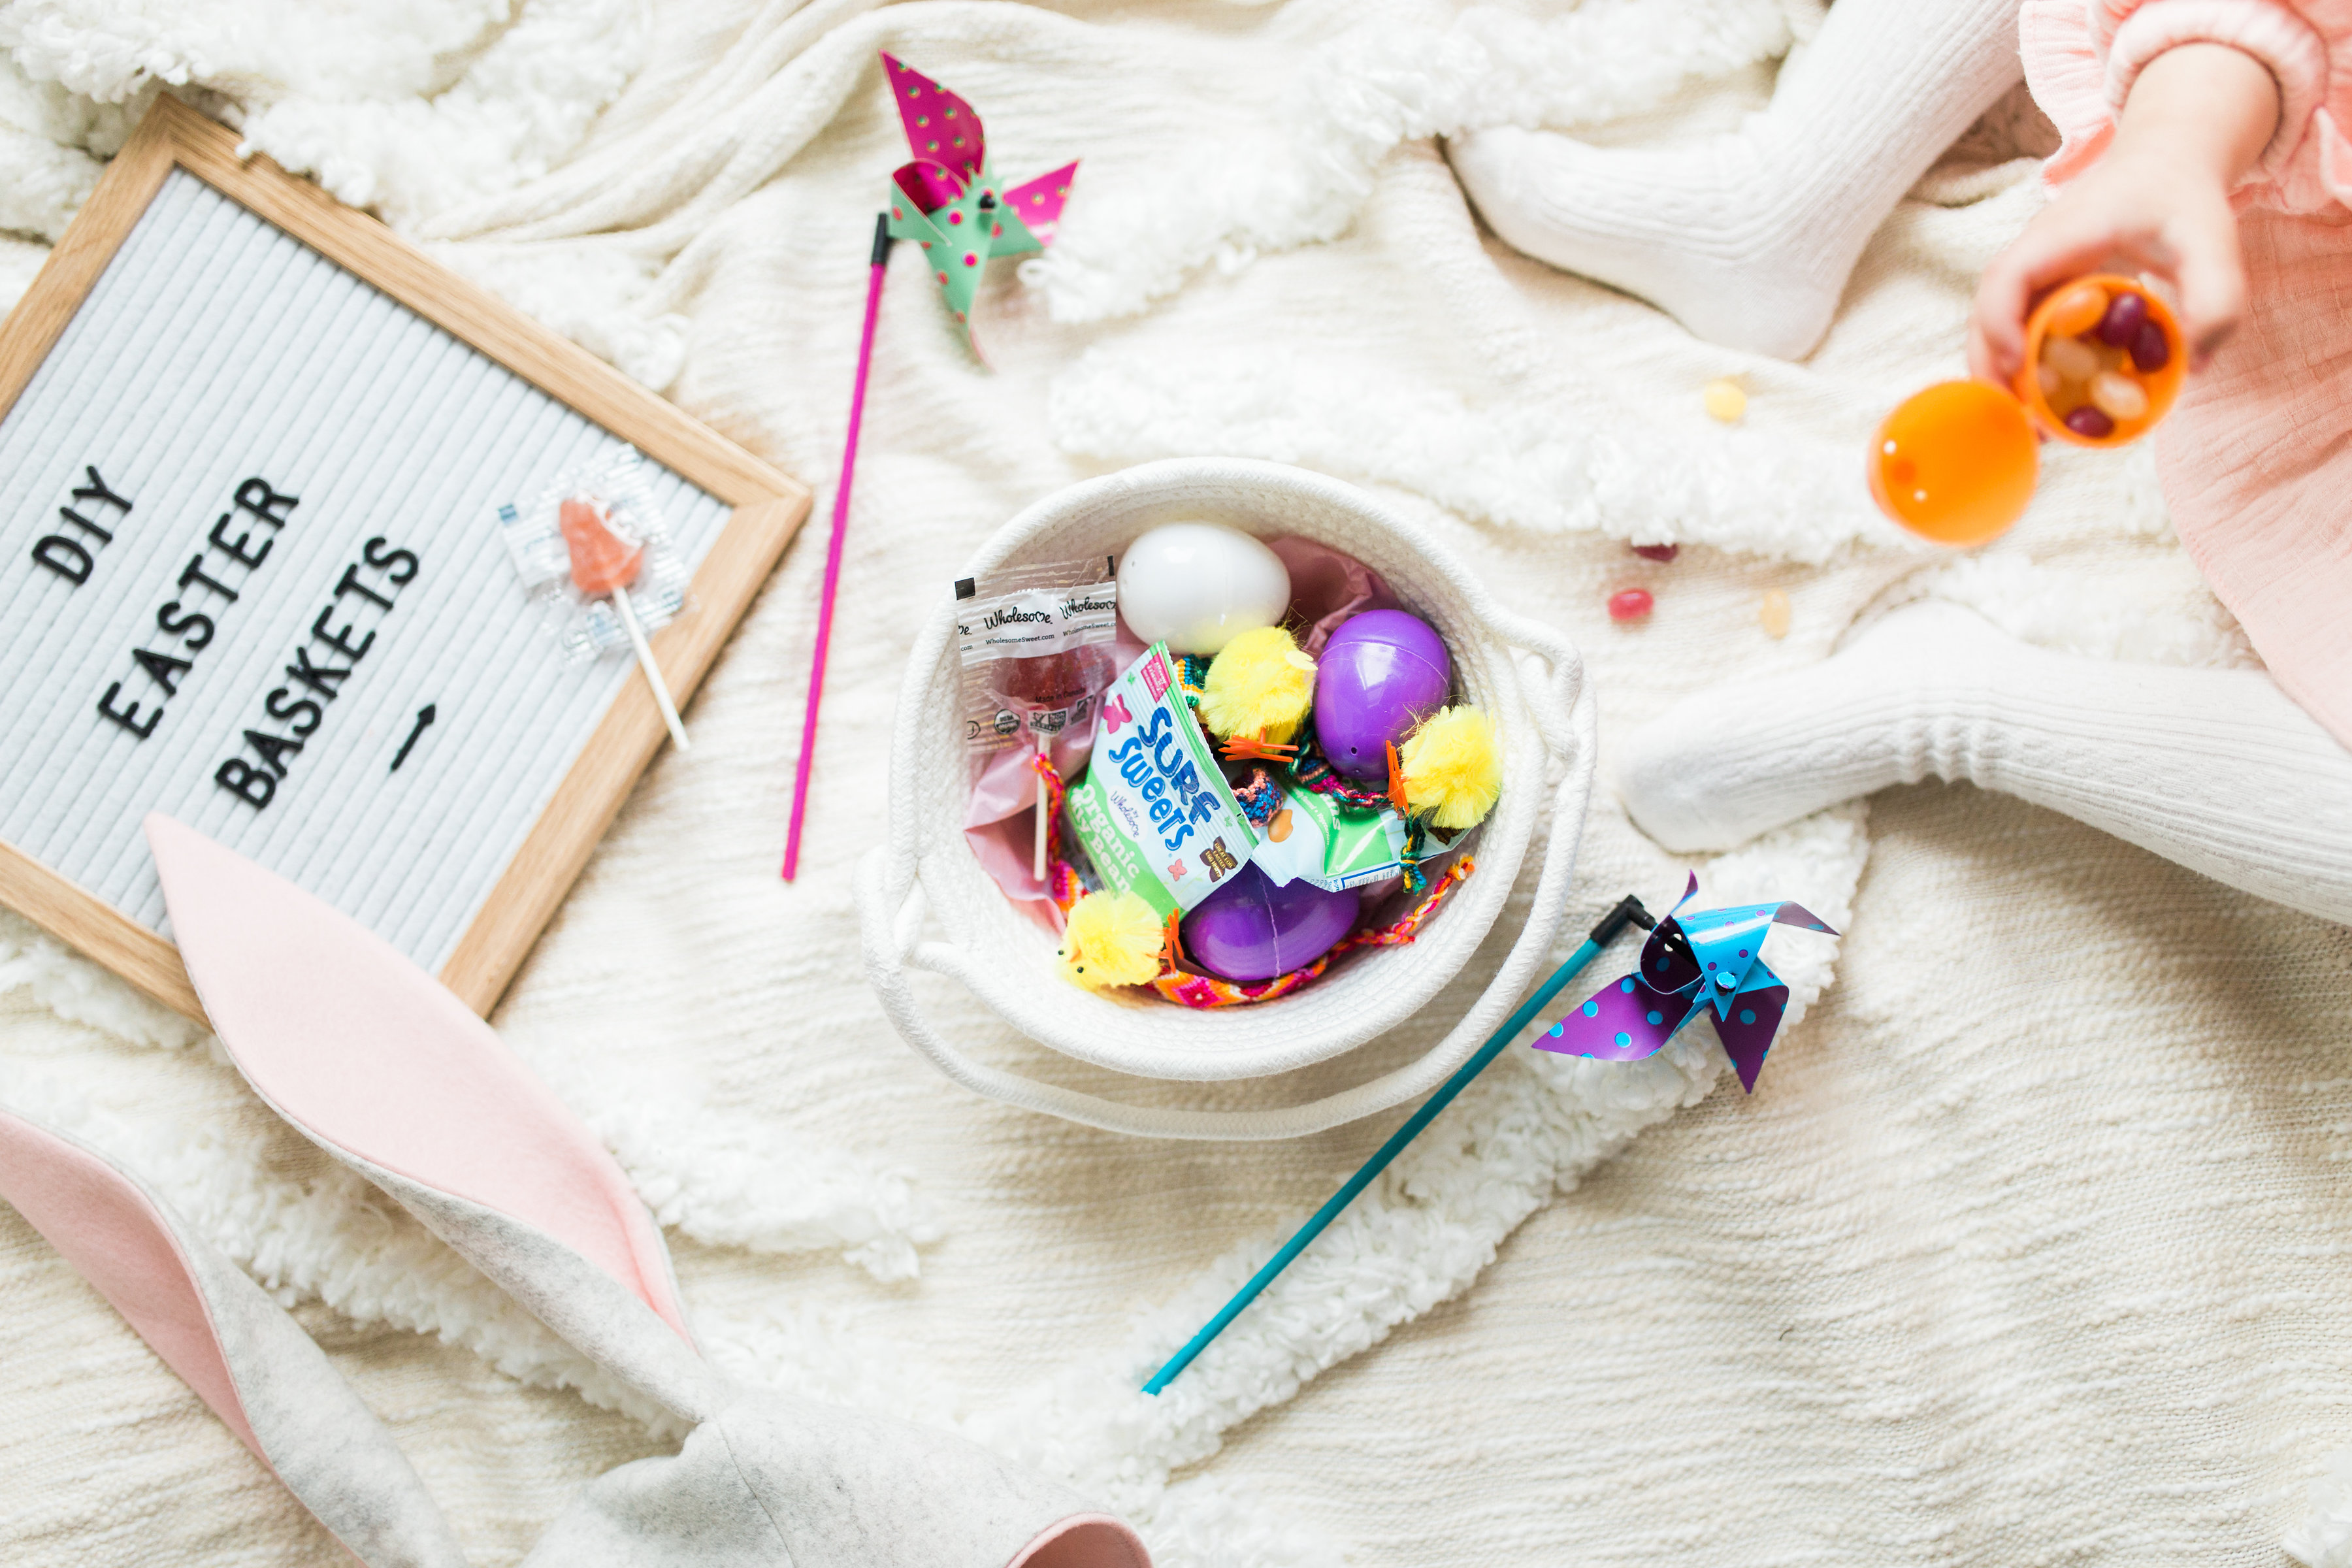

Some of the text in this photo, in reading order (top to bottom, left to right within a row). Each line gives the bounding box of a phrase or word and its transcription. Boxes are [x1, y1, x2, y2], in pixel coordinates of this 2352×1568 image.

[31, 465, 133, 586] DIY
[97, 478, 300, 739] EASTER
[984, 606, 1052, 630] Wholesome
[986, 633, 1054, 645] WholesomeSweet.com
[1060, 596, 1116, 620] Wholesom
[214, 536, 419, 810] BASKETS
[1072, 783, 1140, 879] Organic
[1110, 790, 1139, 838] Wholesome
